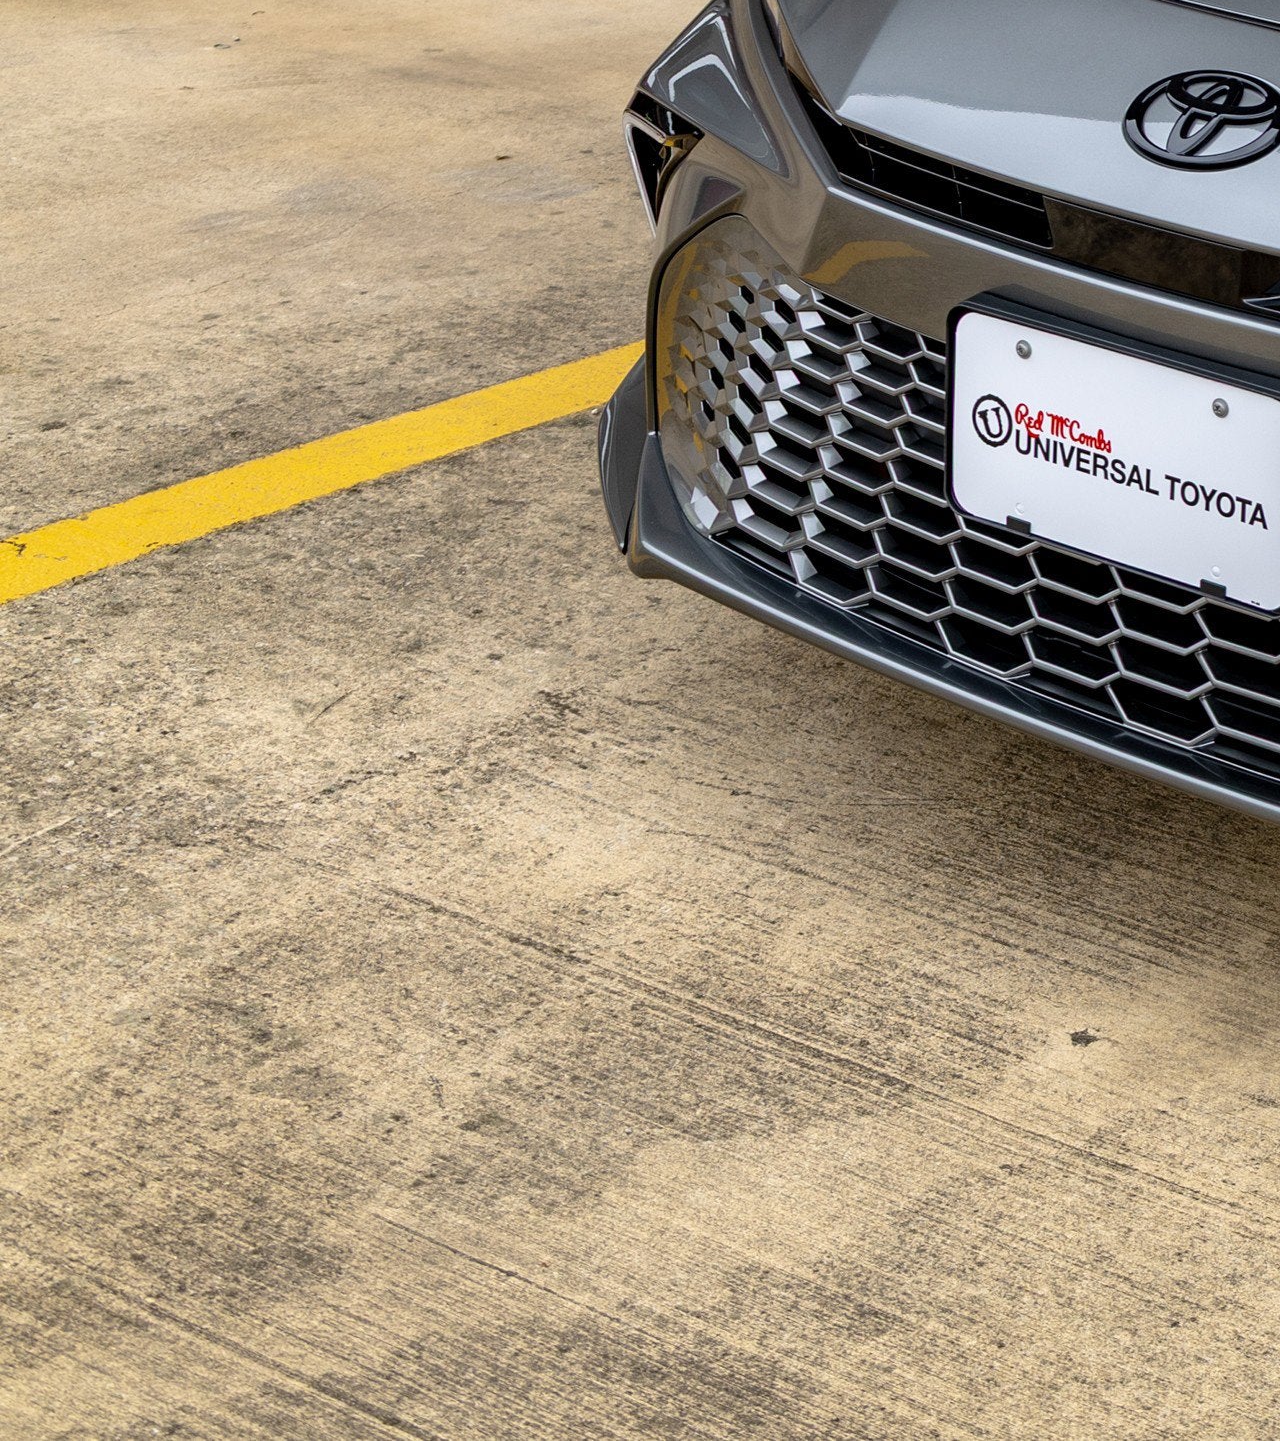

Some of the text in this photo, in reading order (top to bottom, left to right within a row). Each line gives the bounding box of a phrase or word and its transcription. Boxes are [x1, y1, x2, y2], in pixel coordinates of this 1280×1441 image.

[1015, 403, 1112, 454] Red McCombs
[1015, 428, 1269, 530] UNIVERSAL TOYOTA
